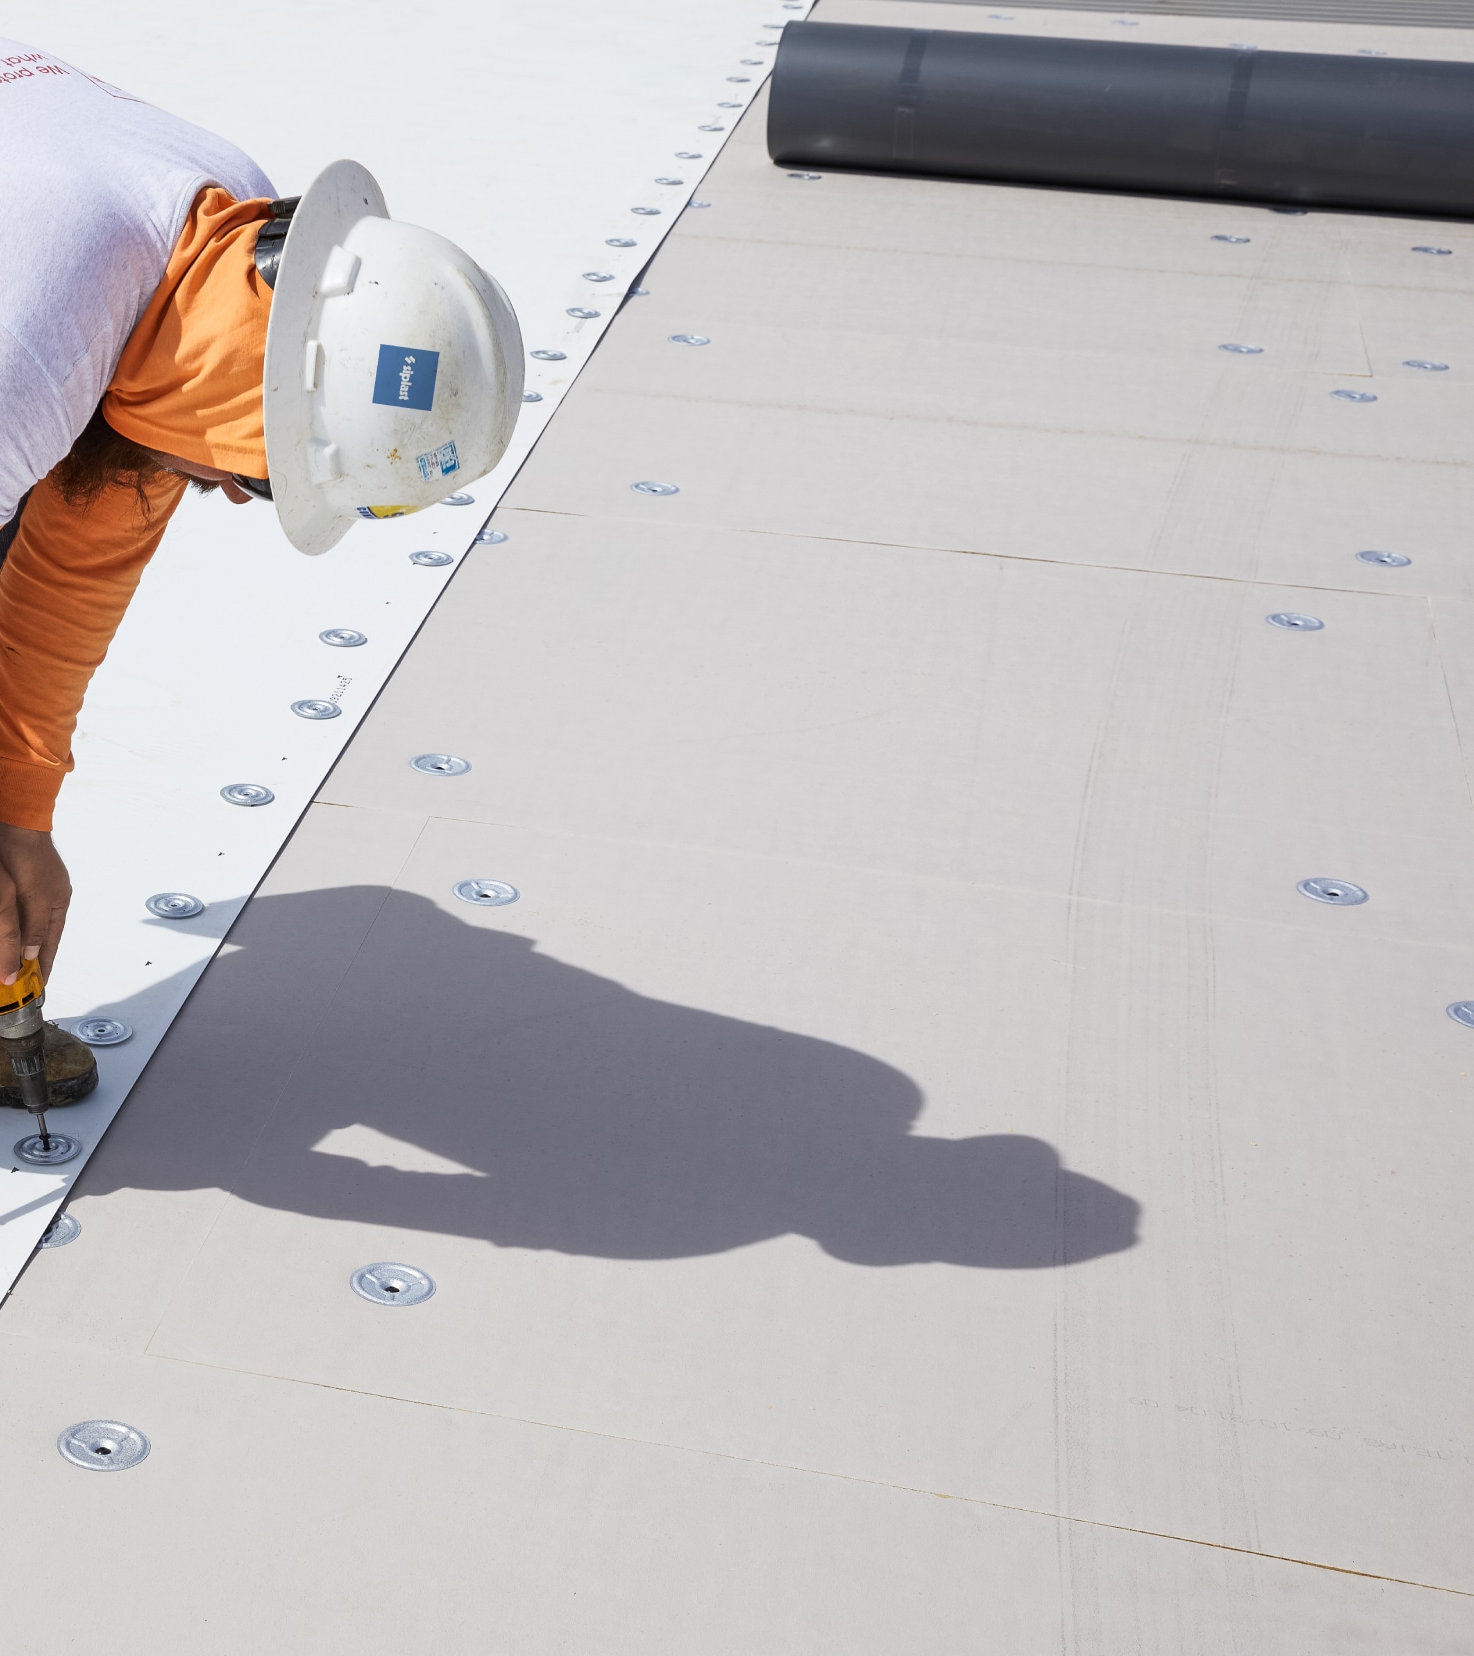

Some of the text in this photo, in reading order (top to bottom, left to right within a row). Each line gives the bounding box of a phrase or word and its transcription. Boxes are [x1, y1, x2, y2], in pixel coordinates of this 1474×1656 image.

[0, 53, 50, 68] what
[35, 64, 70, 75] We
[398, 365, 414, 401] siplast
